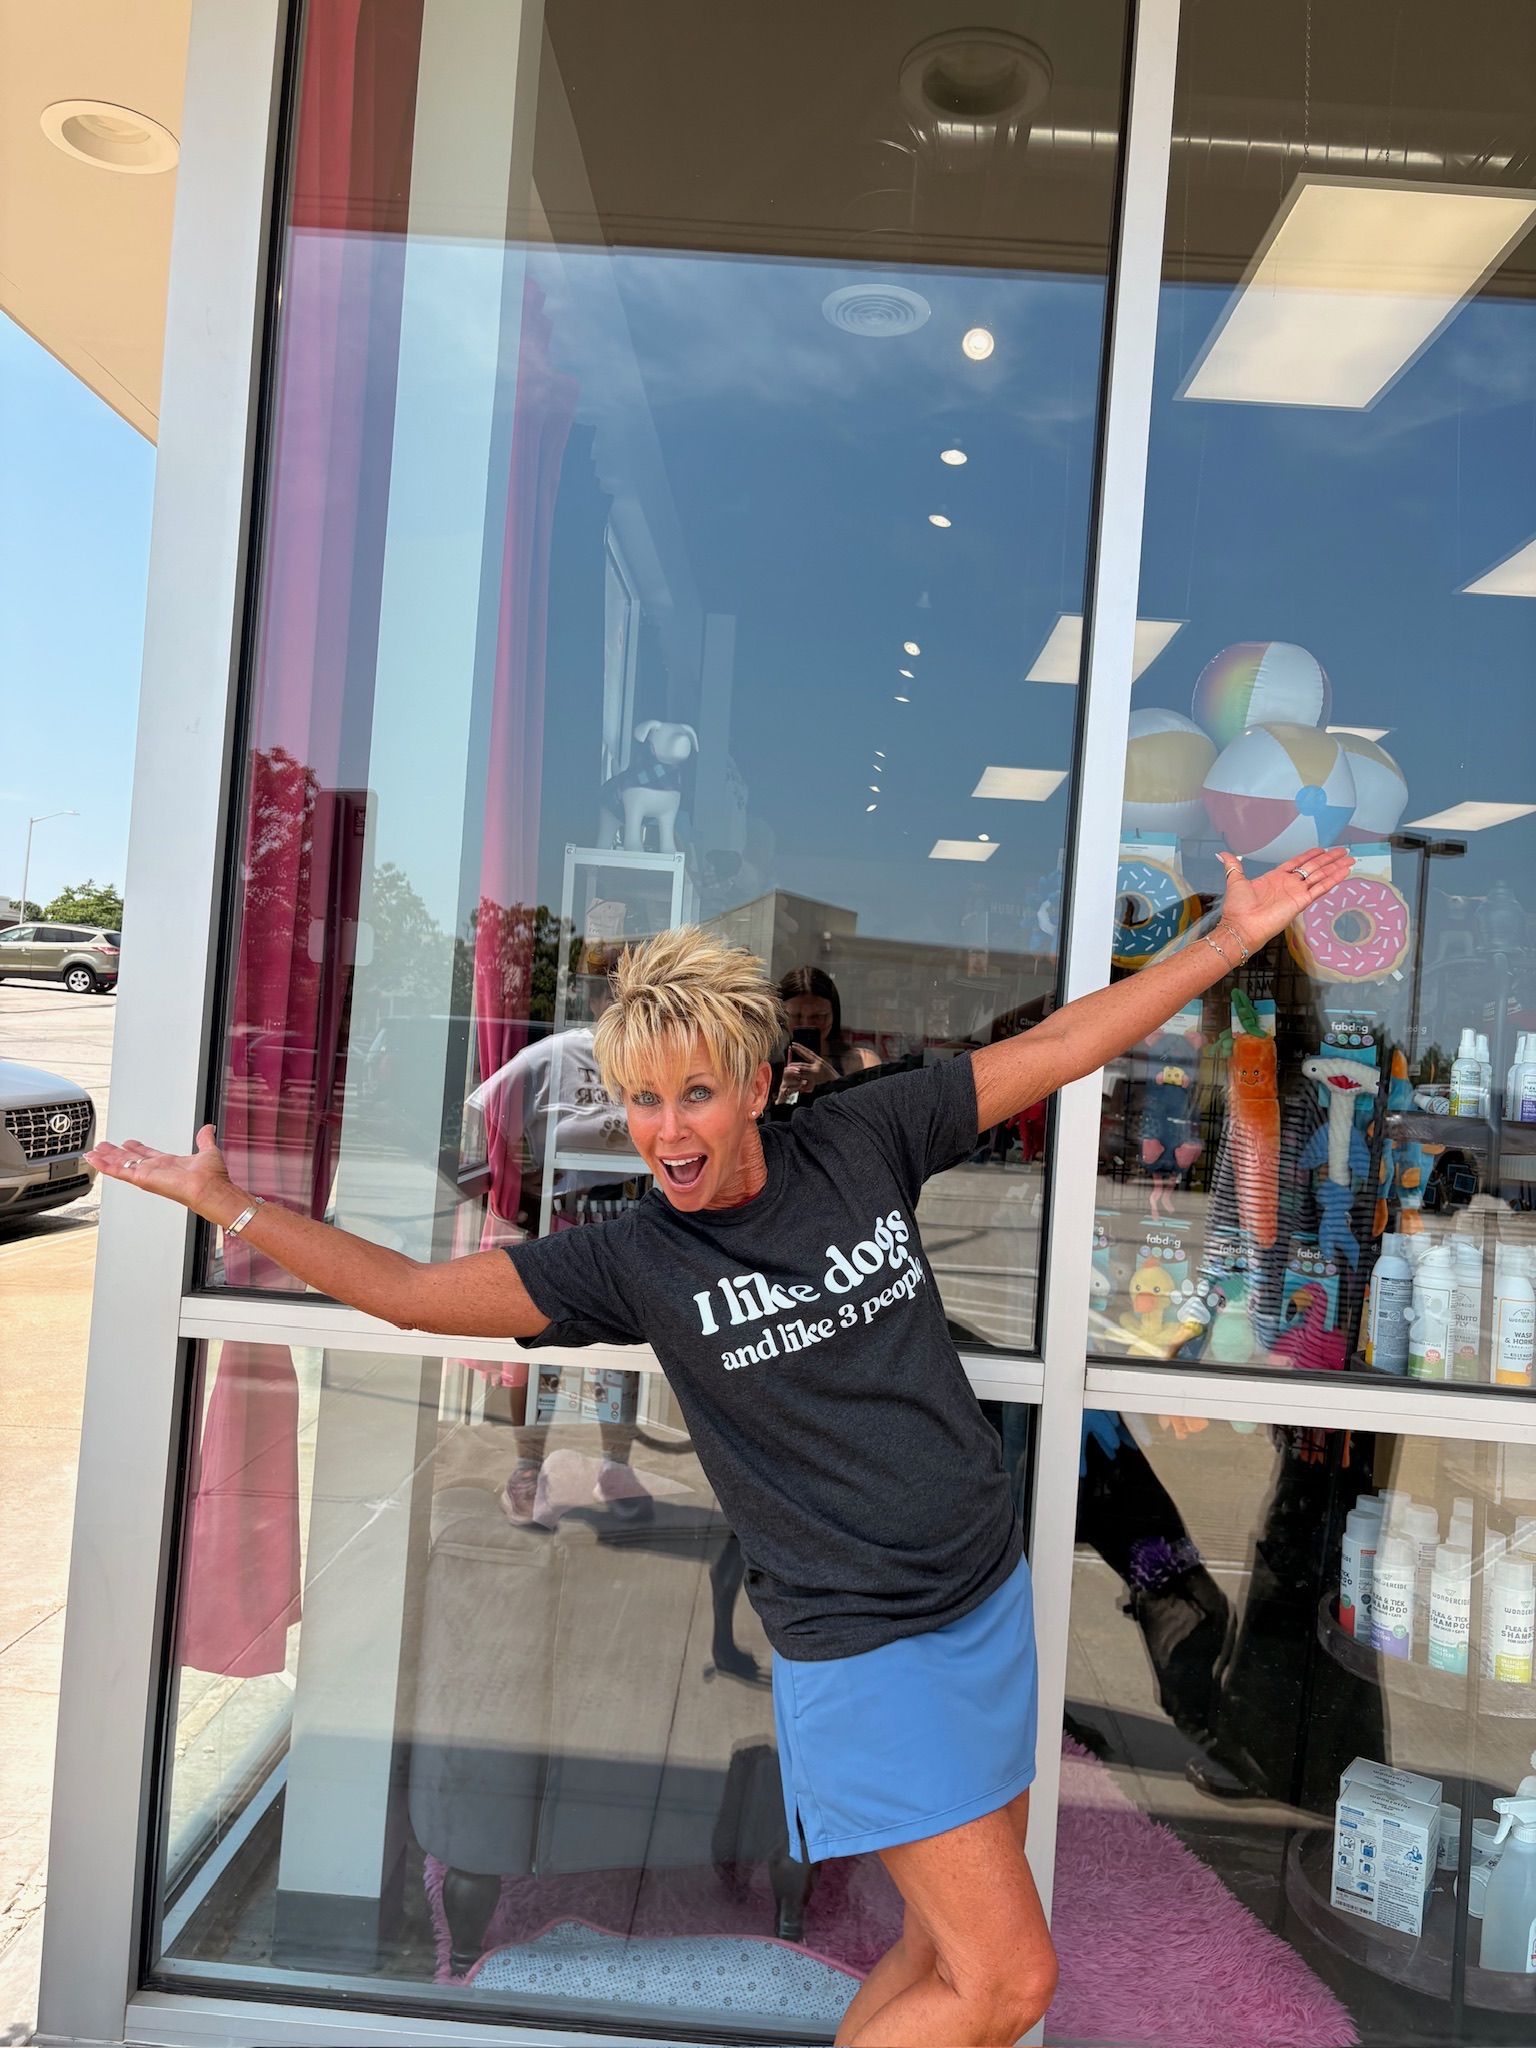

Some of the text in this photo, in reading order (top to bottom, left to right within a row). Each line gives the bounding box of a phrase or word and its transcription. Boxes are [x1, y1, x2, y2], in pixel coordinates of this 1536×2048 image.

[692, 1209, 909, 1336] I like dogs
[720, 1256, 925, 1371] and like 3 people
[1455, 1313, 1478, 1322] QUITO
[1371, 1599, 1408, 1614] HAMPOO
[1505, 1624, 1522, 1633] FLEA
[1501, 1630, 1533, 1640] SHAMP
